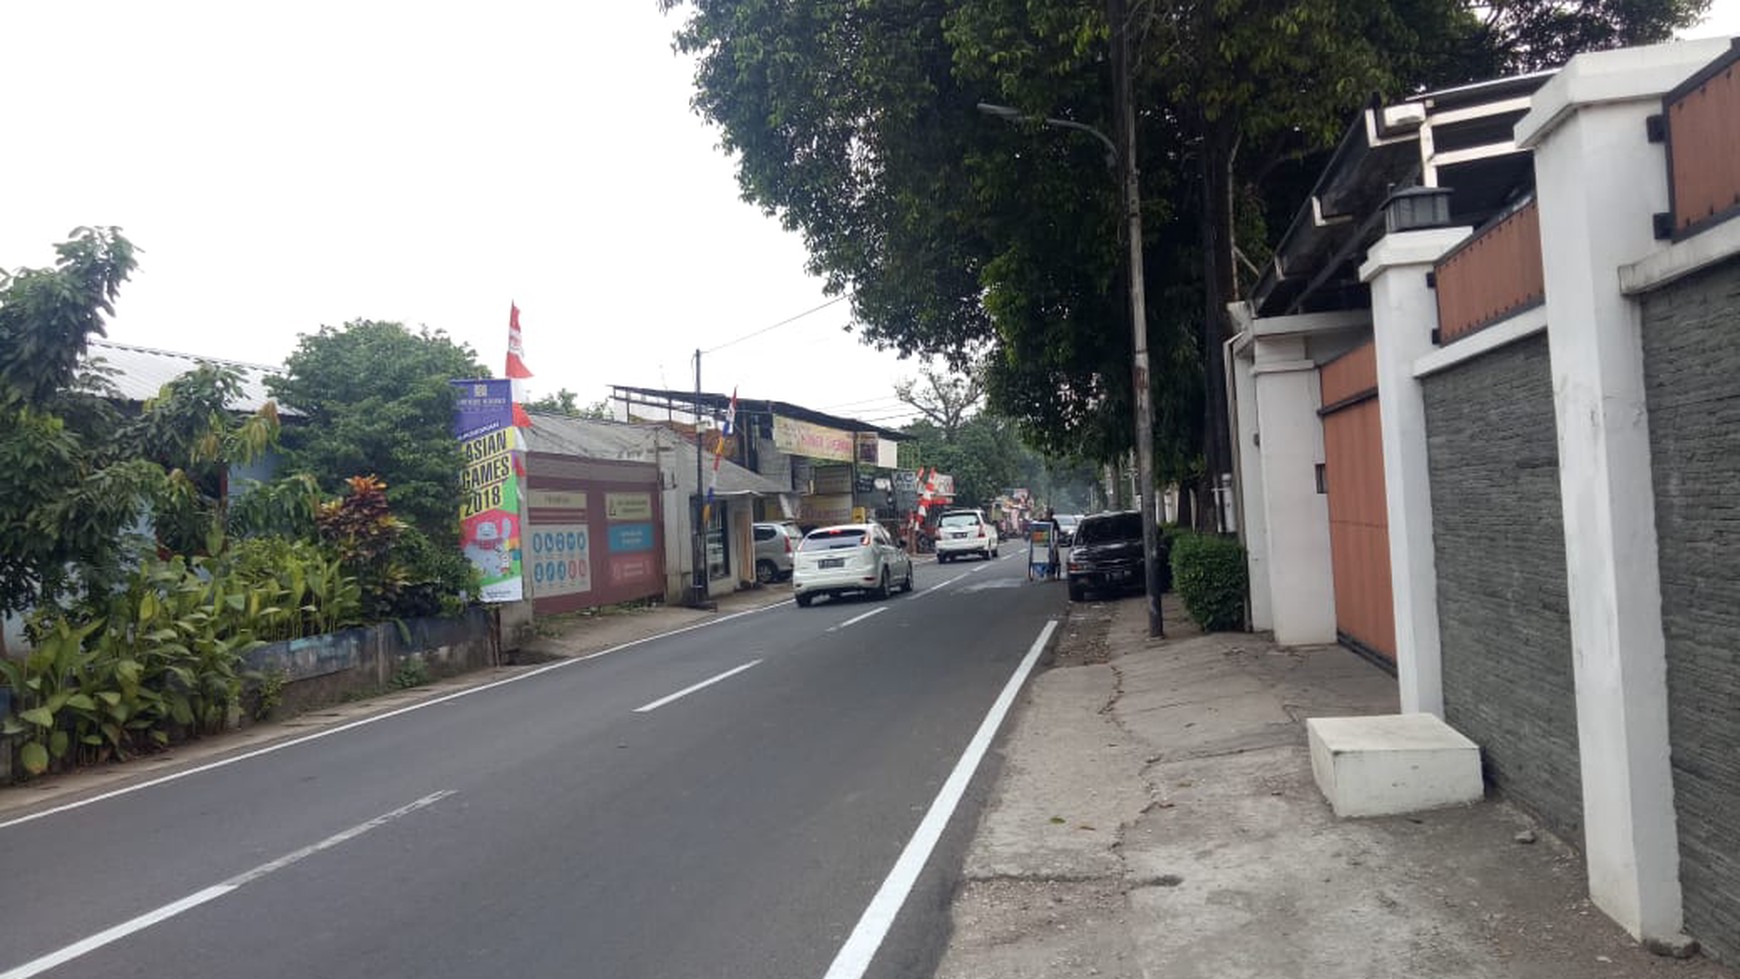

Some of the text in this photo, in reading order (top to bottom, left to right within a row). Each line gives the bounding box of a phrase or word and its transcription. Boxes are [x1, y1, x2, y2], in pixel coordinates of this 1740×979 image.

[466, 430, 506, 463] ASIAN
[462, 455, 510, 491] GAMES
[465, 485, 500, 516] 2018
